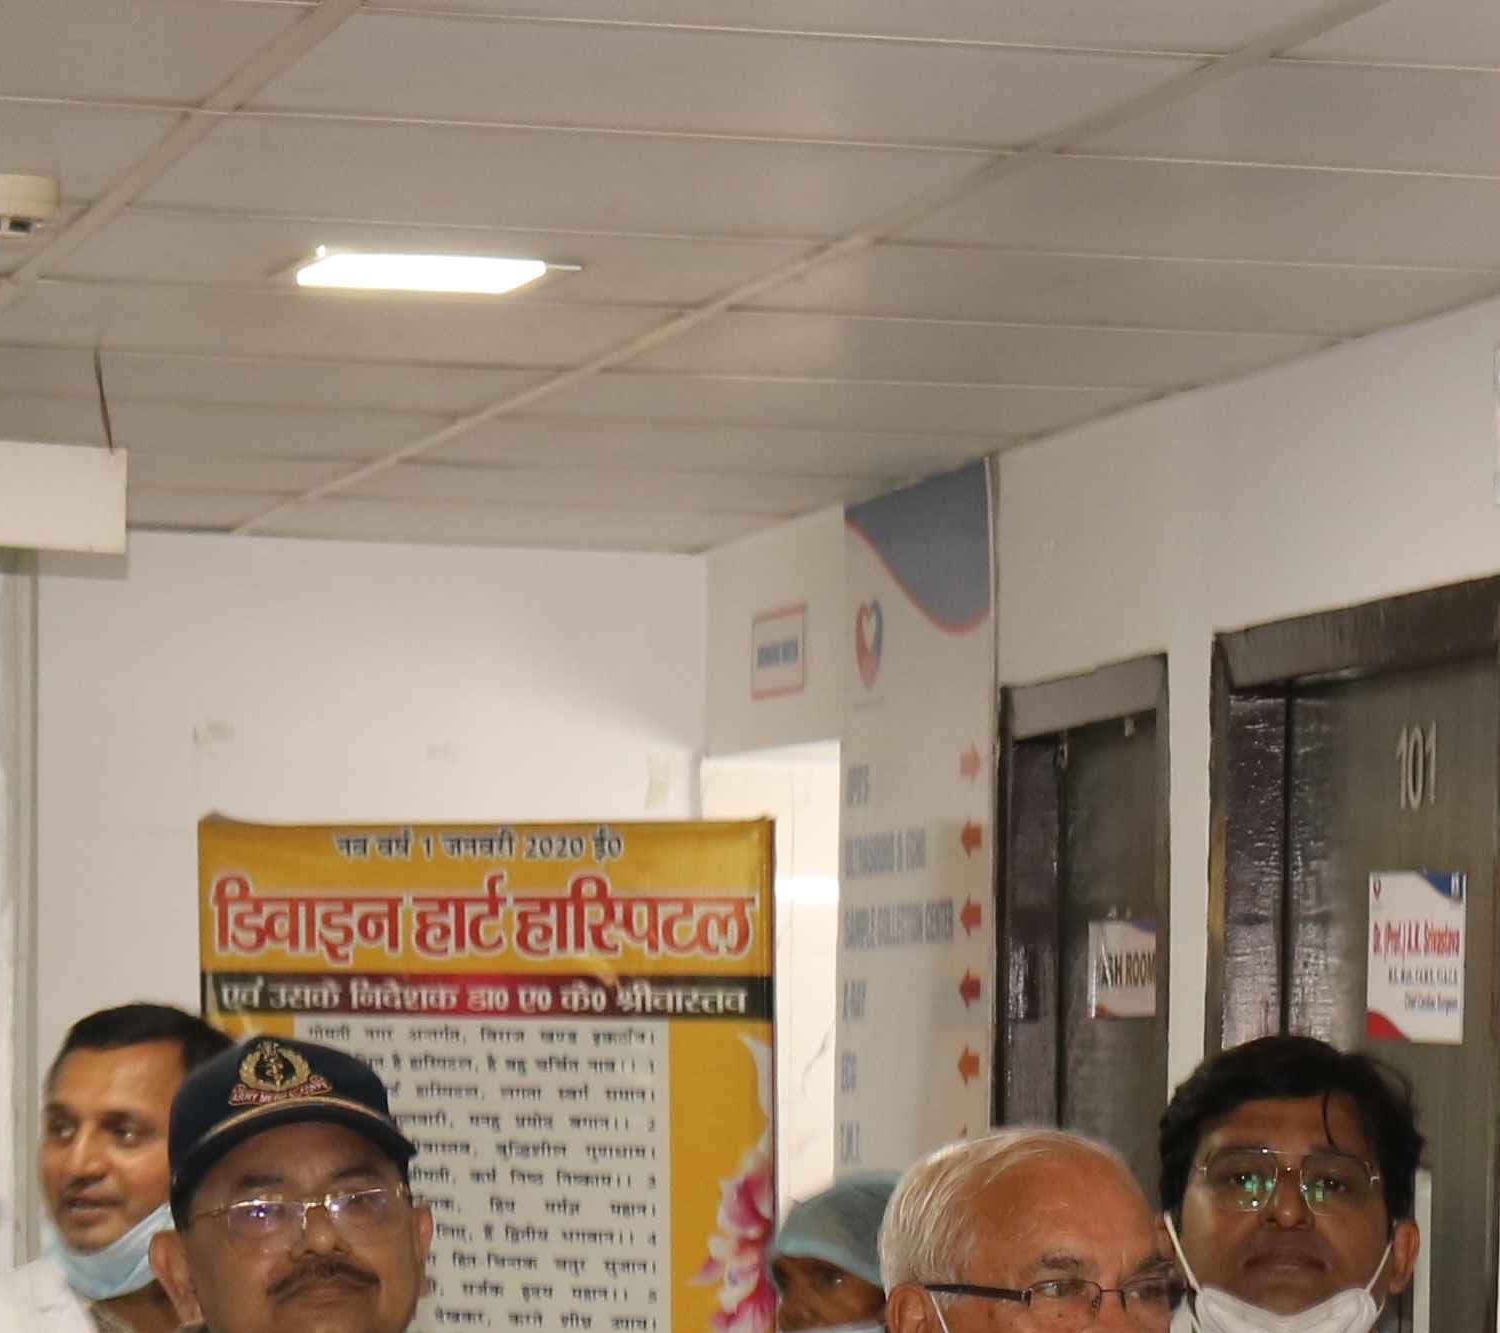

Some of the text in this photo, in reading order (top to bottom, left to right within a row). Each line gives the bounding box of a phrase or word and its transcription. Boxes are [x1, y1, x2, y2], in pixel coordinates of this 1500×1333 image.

[1397, 719, 1438, 813] 101
[524, 837, 585, 860] 2020
[212, 873, 754, 964] डिवाइन हार्ट हास्पिटल
